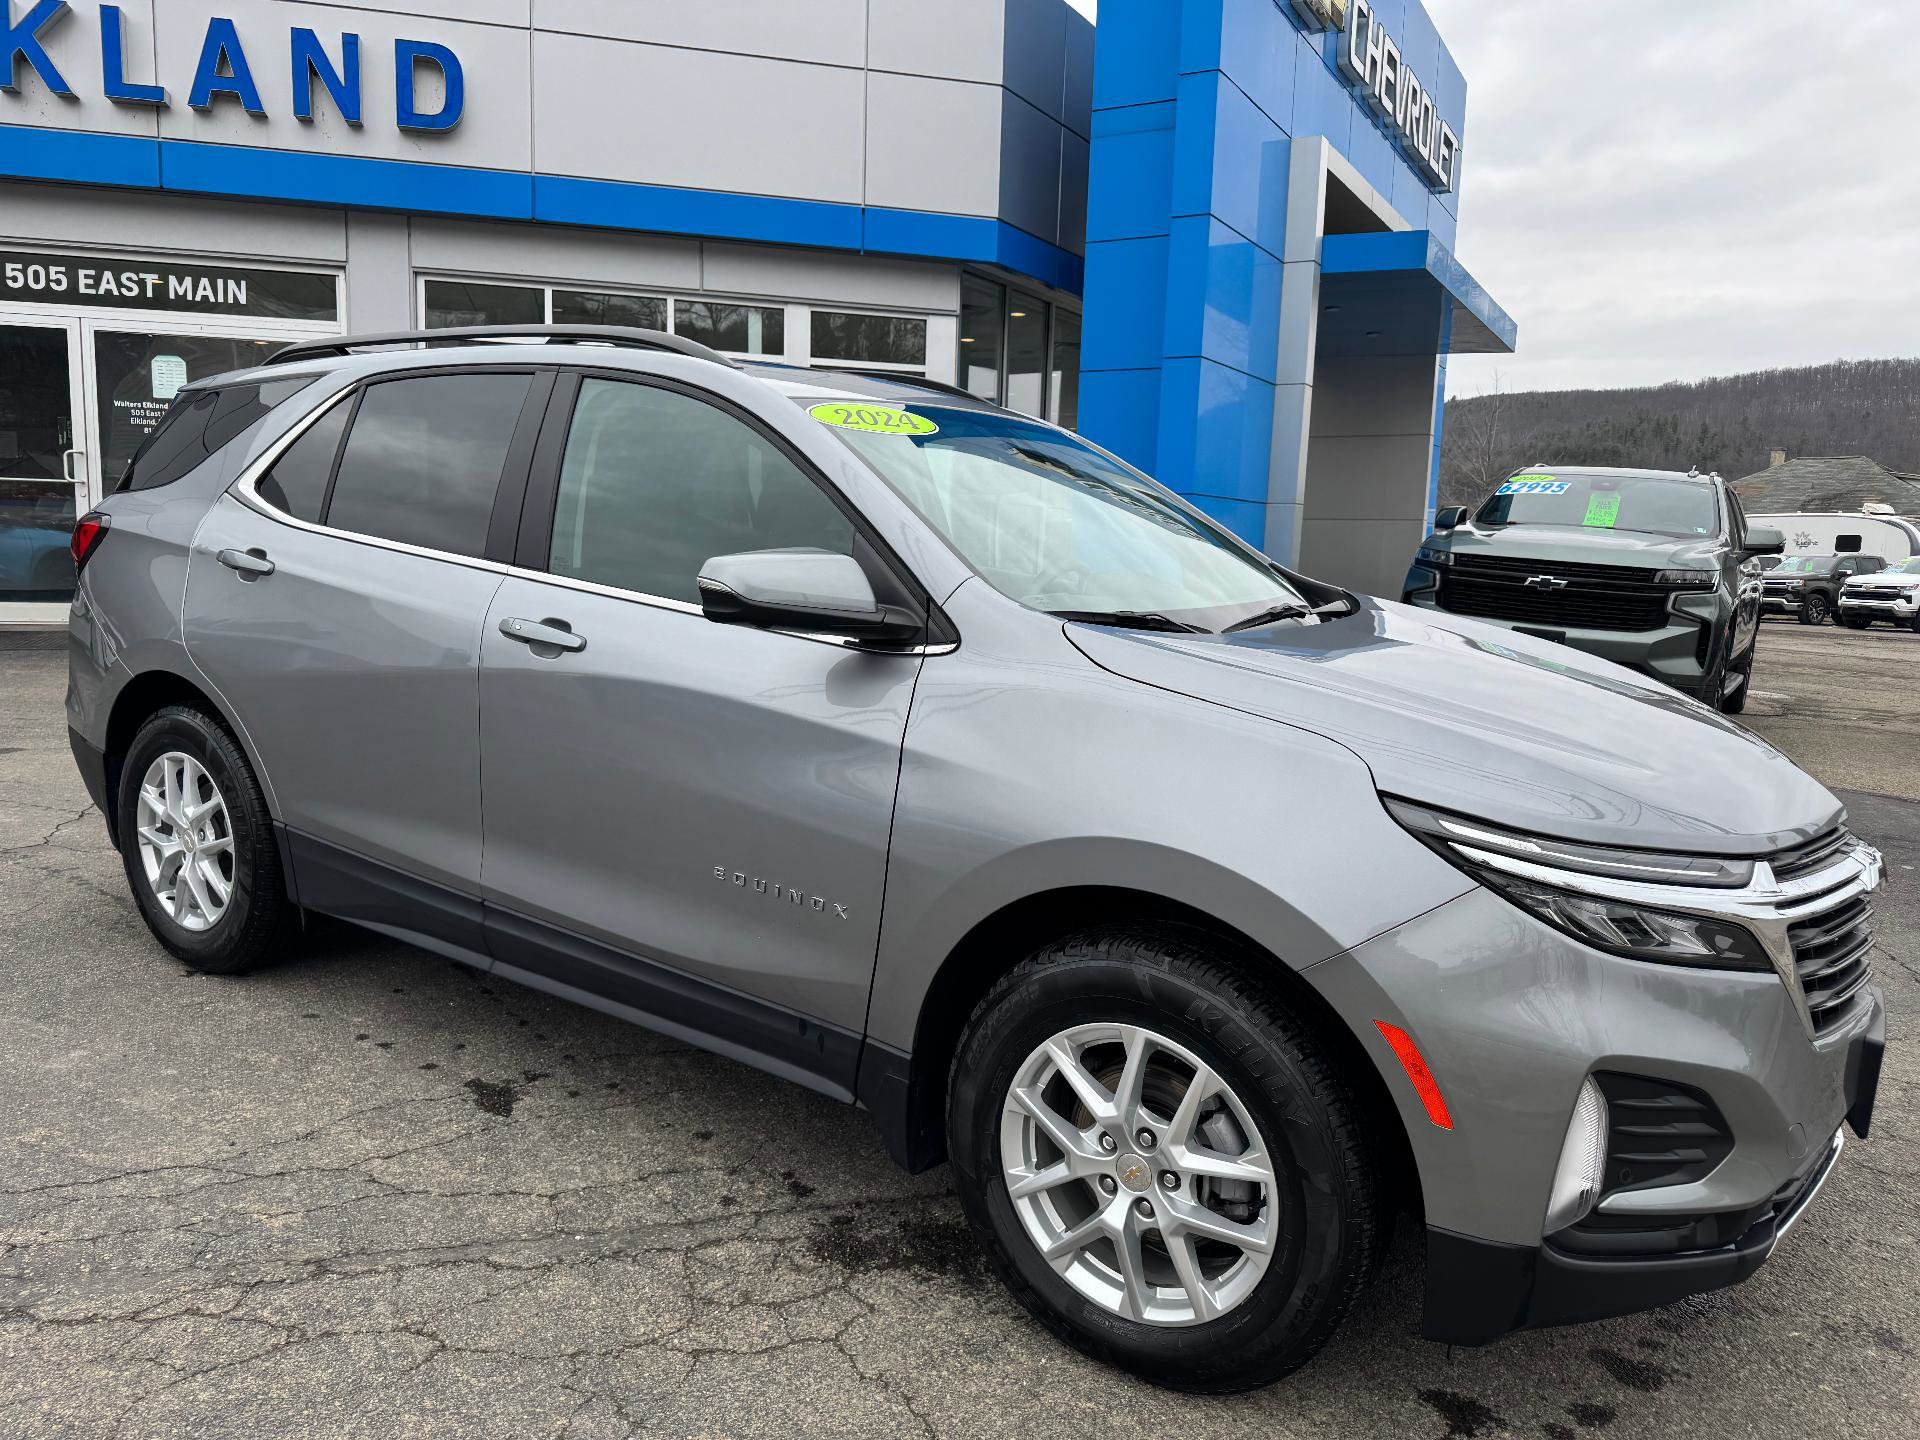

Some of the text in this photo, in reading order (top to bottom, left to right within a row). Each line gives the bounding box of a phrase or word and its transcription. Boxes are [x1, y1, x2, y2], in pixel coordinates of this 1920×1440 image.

[0, 0, 466, 134] KLAND
[1346, 0, 1460, 192] CHEVROLET
[5, 262, 247, 305] 505 EAST MAIN
[113, 400, 169, 410] Walters Elkland
[833, 408, 921, 430] 2024
[1498, 482, 1569, 494] 62995
[712, 865, 848, 921] EQUINOX
[1183, 999, 1312, 1127] KELLY
